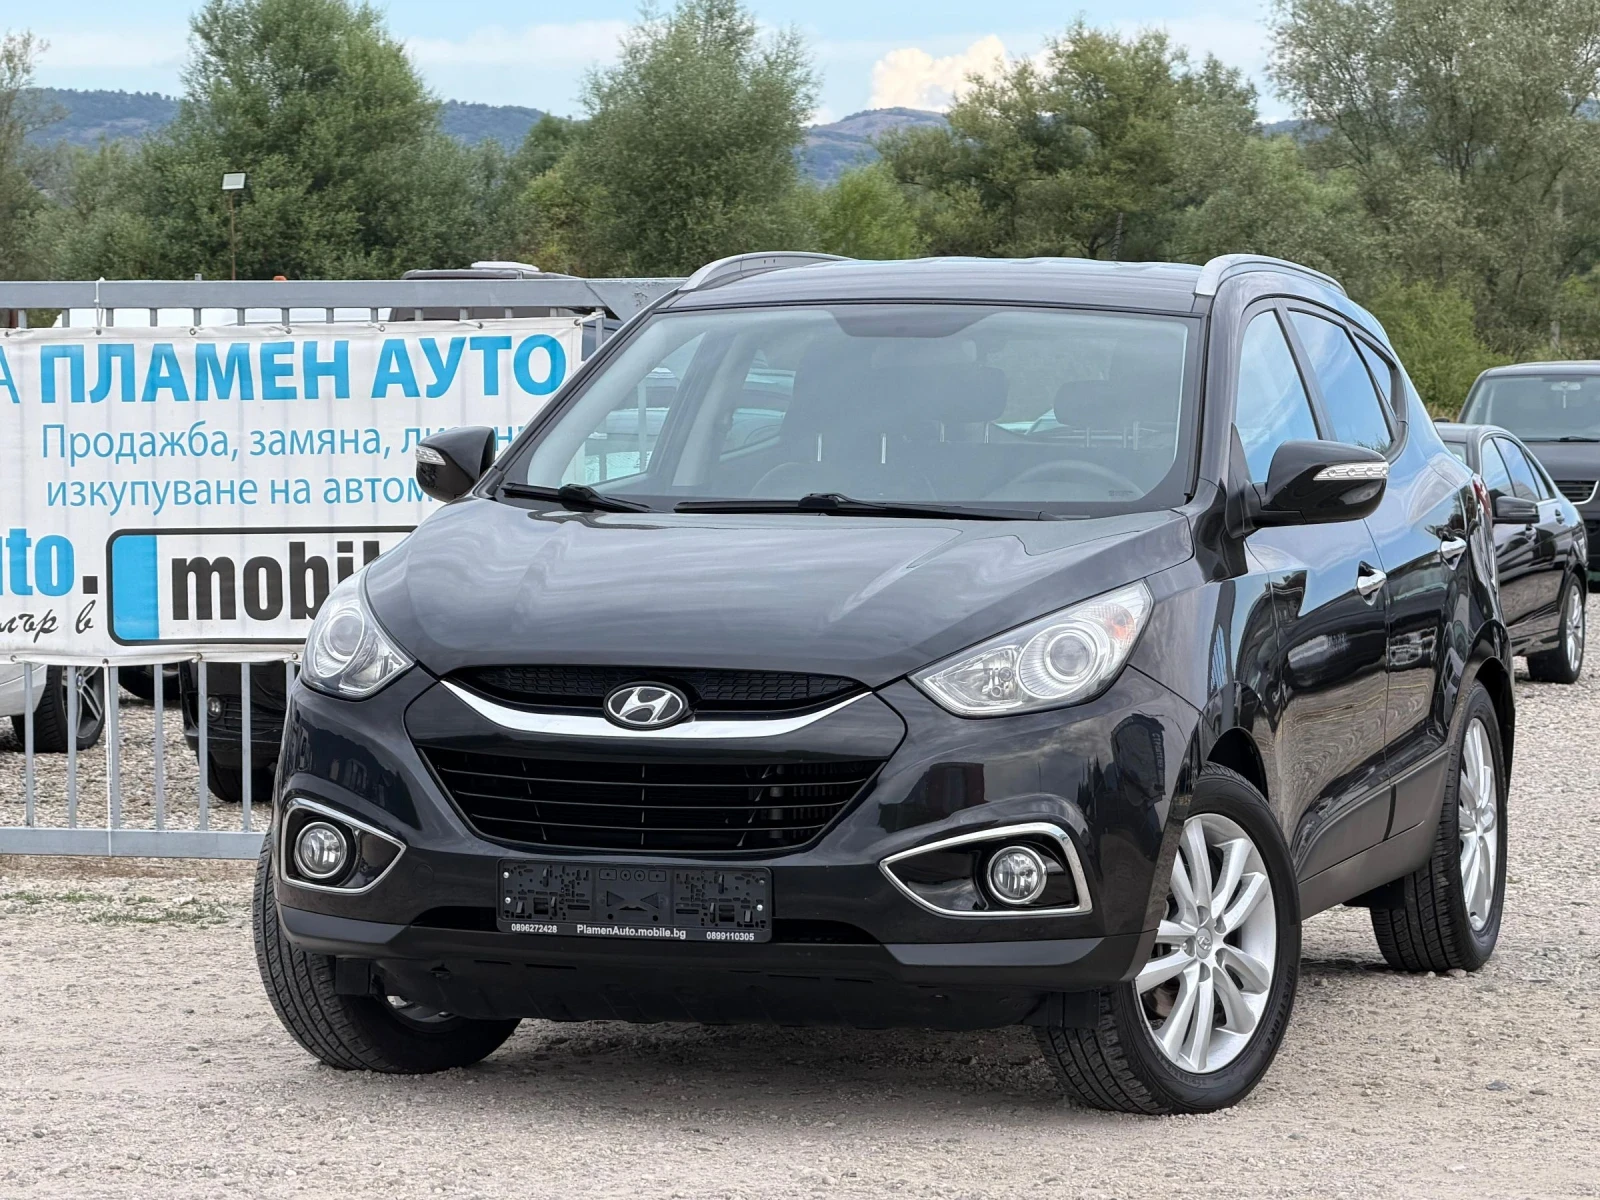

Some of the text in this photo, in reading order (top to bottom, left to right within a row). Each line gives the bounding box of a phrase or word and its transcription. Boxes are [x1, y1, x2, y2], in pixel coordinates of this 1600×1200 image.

[40, 340, 351, 405] ПЛАМЕН
[370, 333, 568, 400] АУТО
[42, 421, 239, 467] Продажба,
[249, 427, 391, 461] замяна,
[47, 478, 258, 517] изкупуване
[269, 478, 311, 505] на
[0, 528, 380, 621] to. mobi
[511, 923, 755, 941] 0896272428 PlamenAuto.mobile.bg 0899110305
